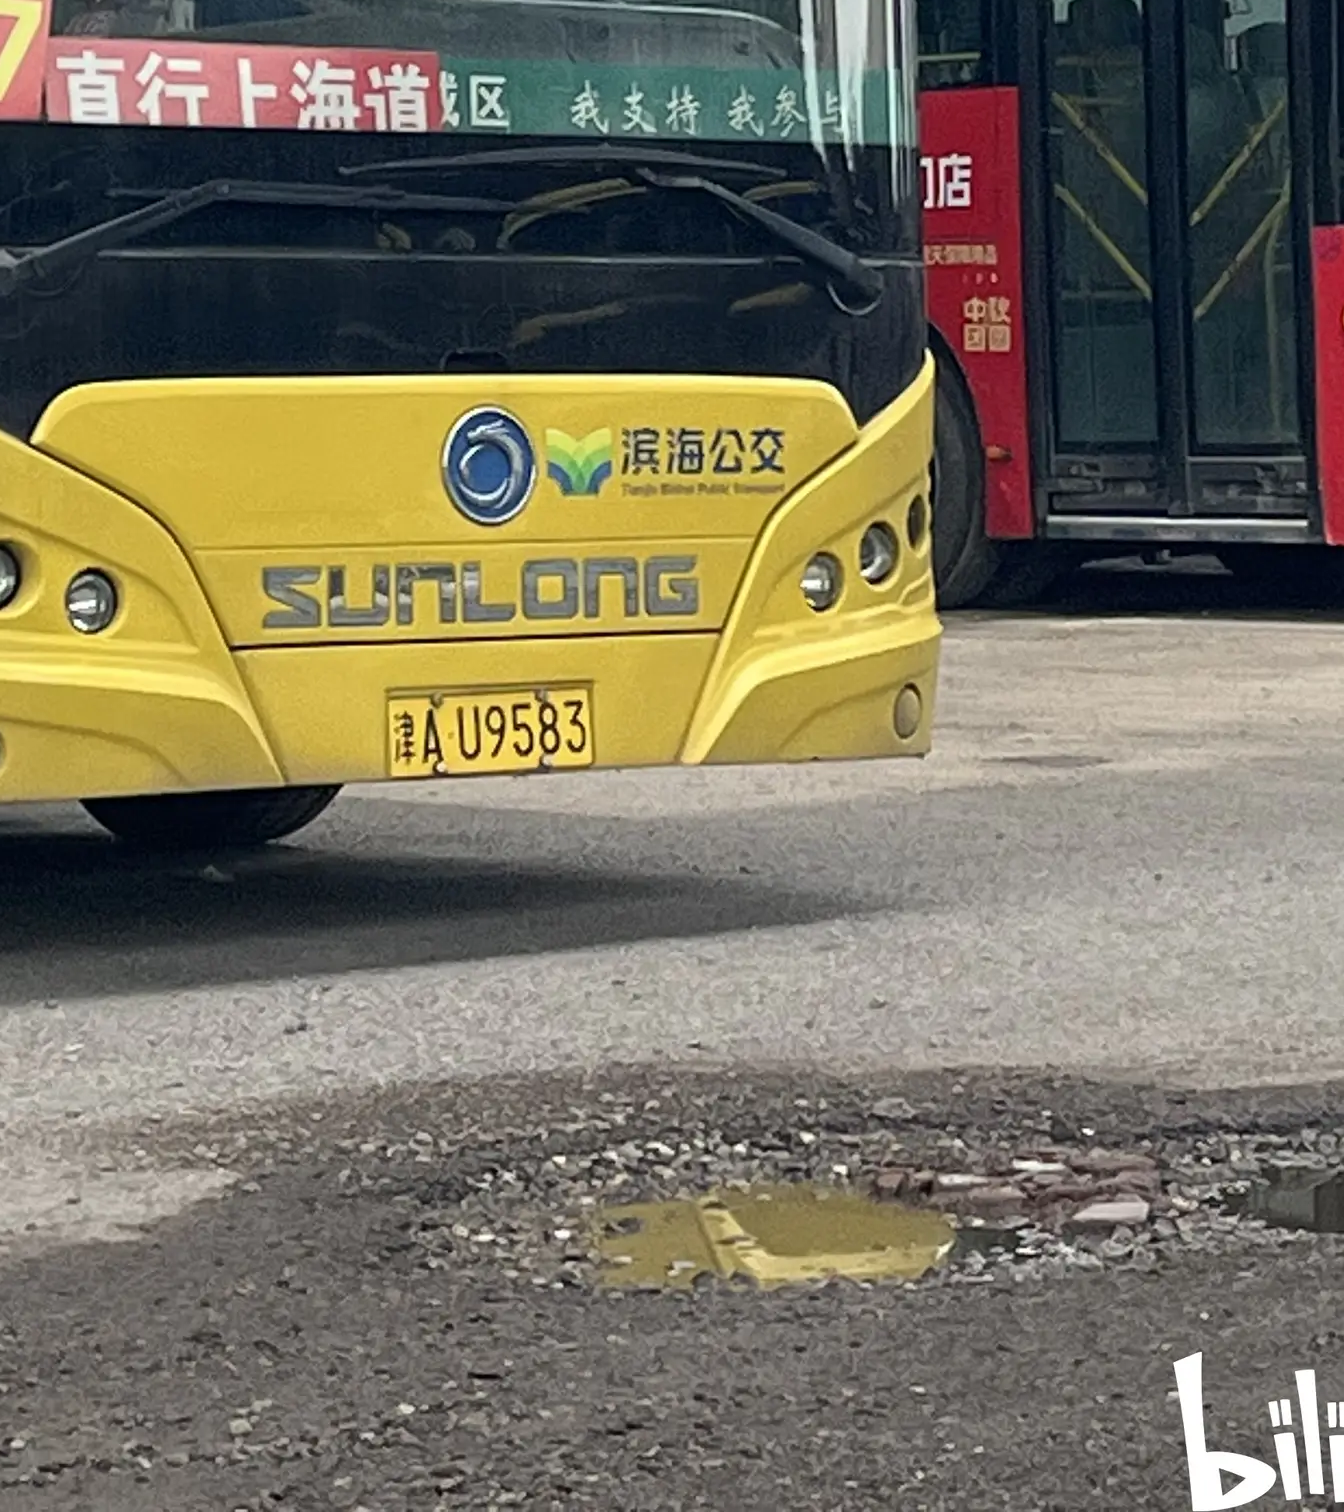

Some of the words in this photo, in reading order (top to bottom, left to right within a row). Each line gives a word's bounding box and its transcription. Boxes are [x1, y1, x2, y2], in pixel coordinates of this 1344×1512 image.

[56, 50, 430, 132] 直行上海道
[570, 79, 702, 136] 我支持
[621, 427, 786, 475] 滨海公交
[261, 554, 700, 629] SUNLONG
